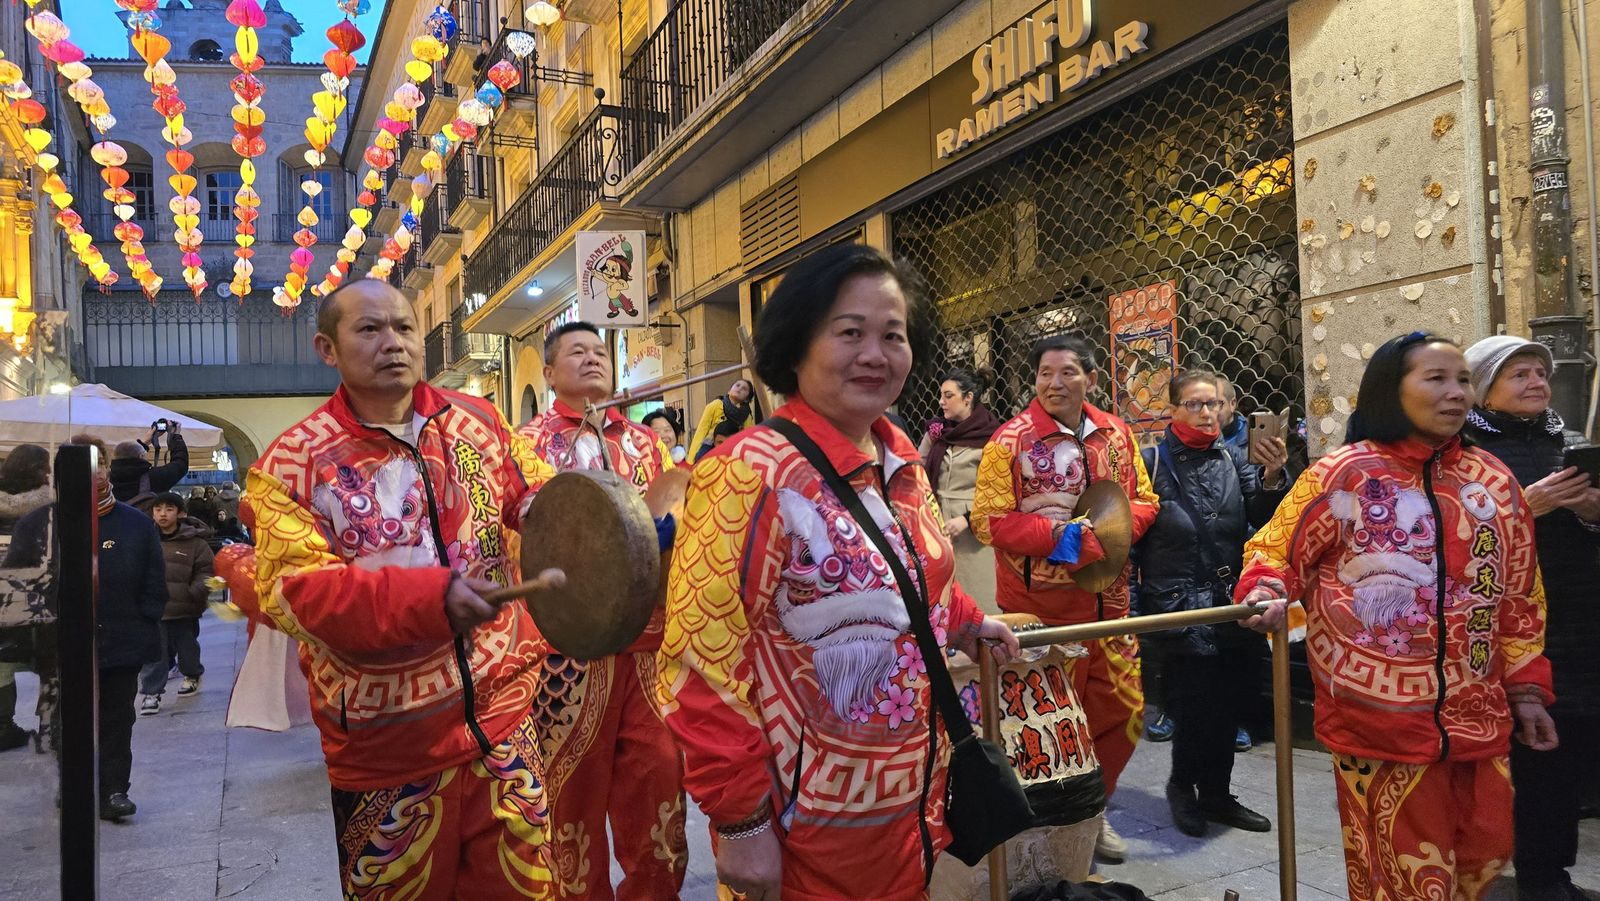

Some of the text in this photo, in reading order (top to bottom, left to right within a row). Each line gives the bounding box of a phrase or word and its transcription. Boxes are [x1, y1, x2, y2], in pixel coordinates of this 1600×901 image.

[936, 20, 1149, 159] RAMEN BAR
[972, 0, 1092, 105] SHIFU
